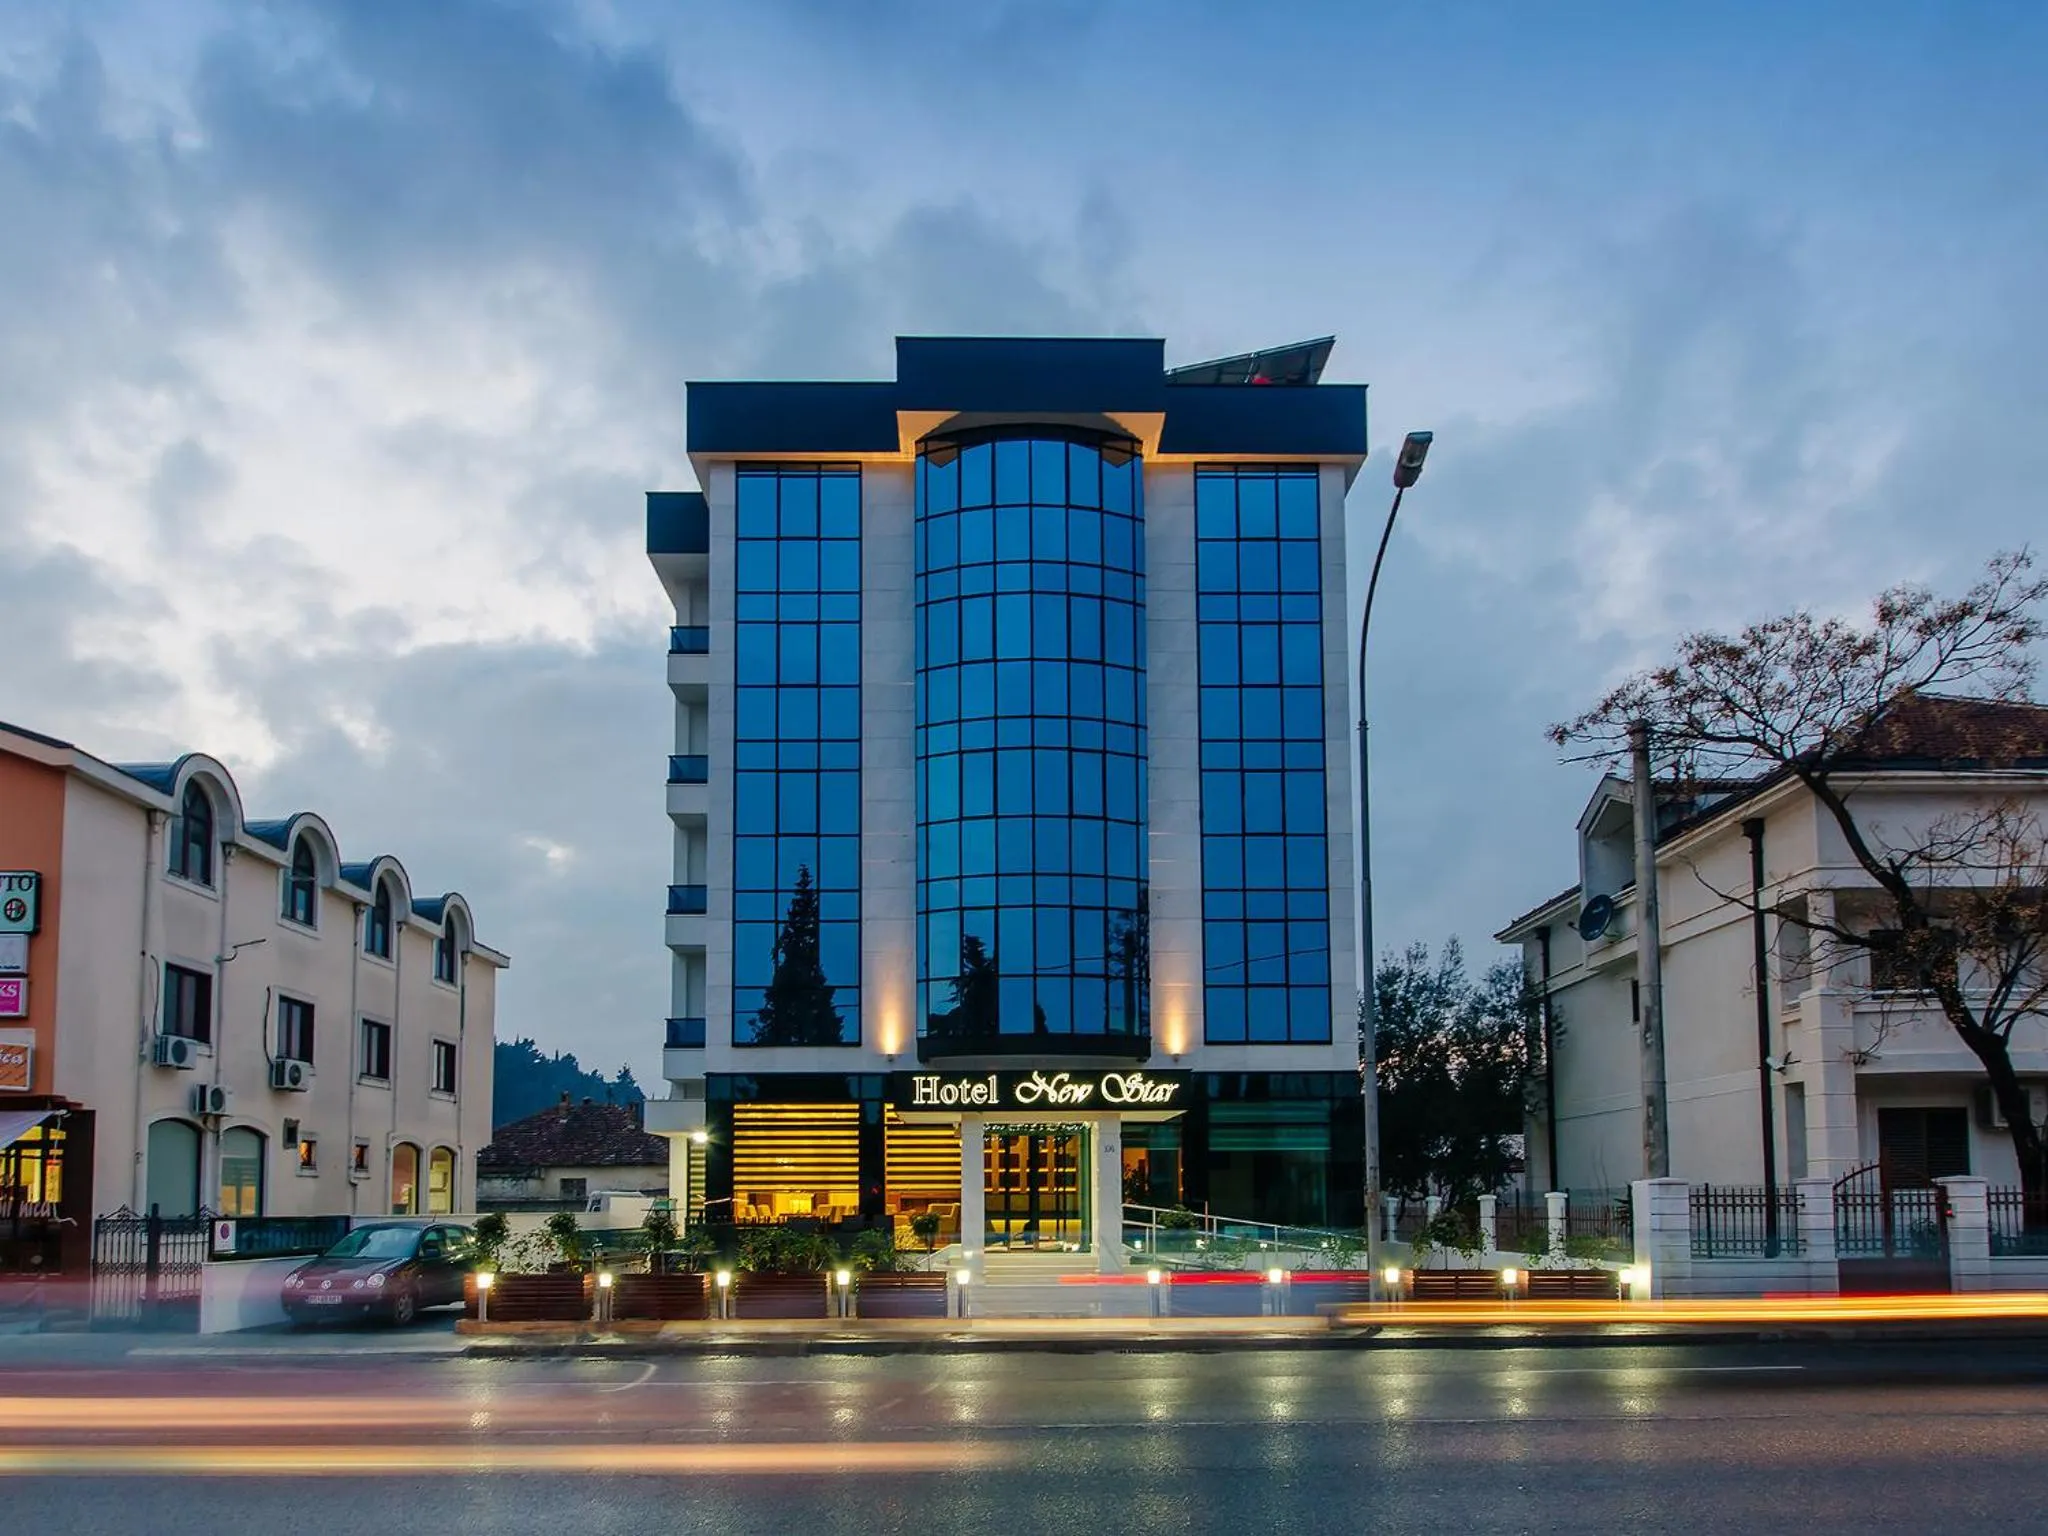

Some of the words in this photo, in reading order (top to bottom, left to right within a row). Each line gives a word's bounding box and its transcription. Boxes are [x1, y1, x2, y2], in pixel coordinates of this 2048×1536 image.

[0, 875, 33, 892] TO
[912, 1074, 1000, 1104] Hotel
[1015, 1070, 1094, 1103] New
[1101, 1072, 1180, 1103] Star
